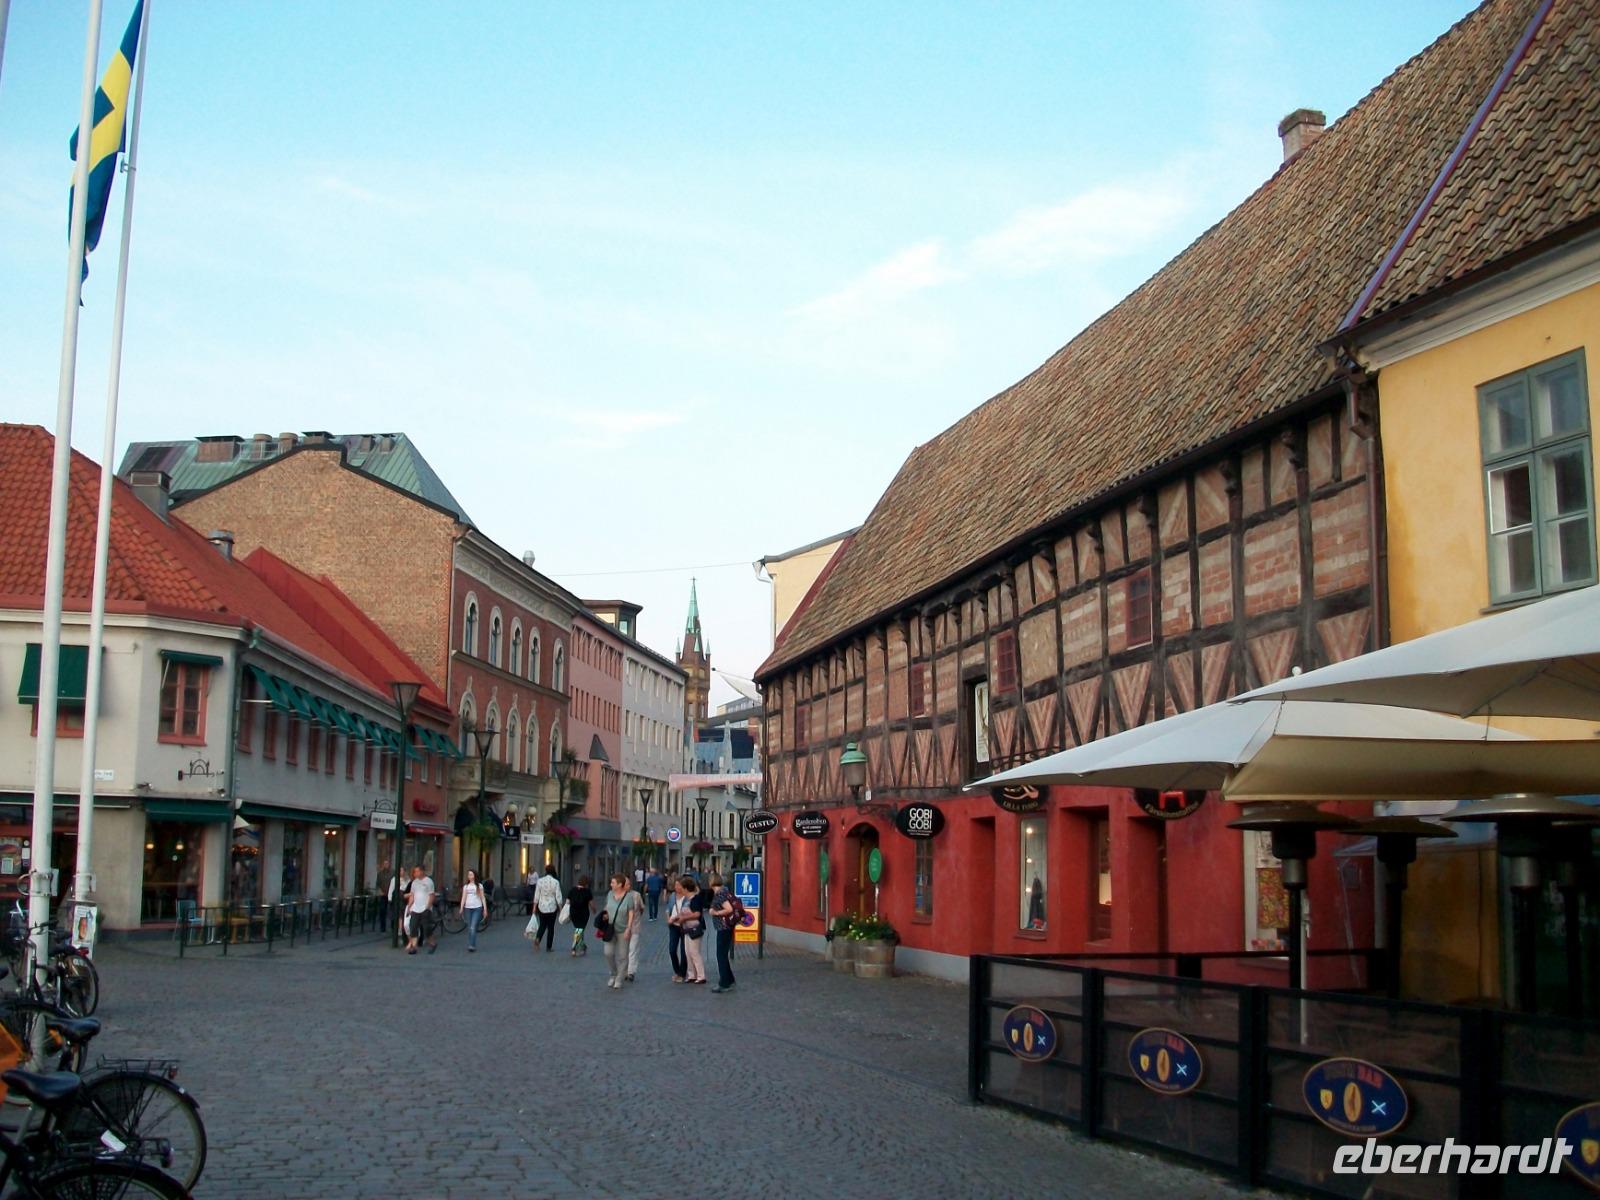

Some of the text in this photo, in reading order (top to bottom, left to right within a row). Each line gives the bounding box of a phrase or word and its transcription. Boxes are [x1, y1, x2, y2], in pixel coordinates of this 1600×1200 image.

[909, 807, 933, 820] GOBI
[748, 819, 775, 829] GUSTUS
[909, 819, 932, 830] GOBI
